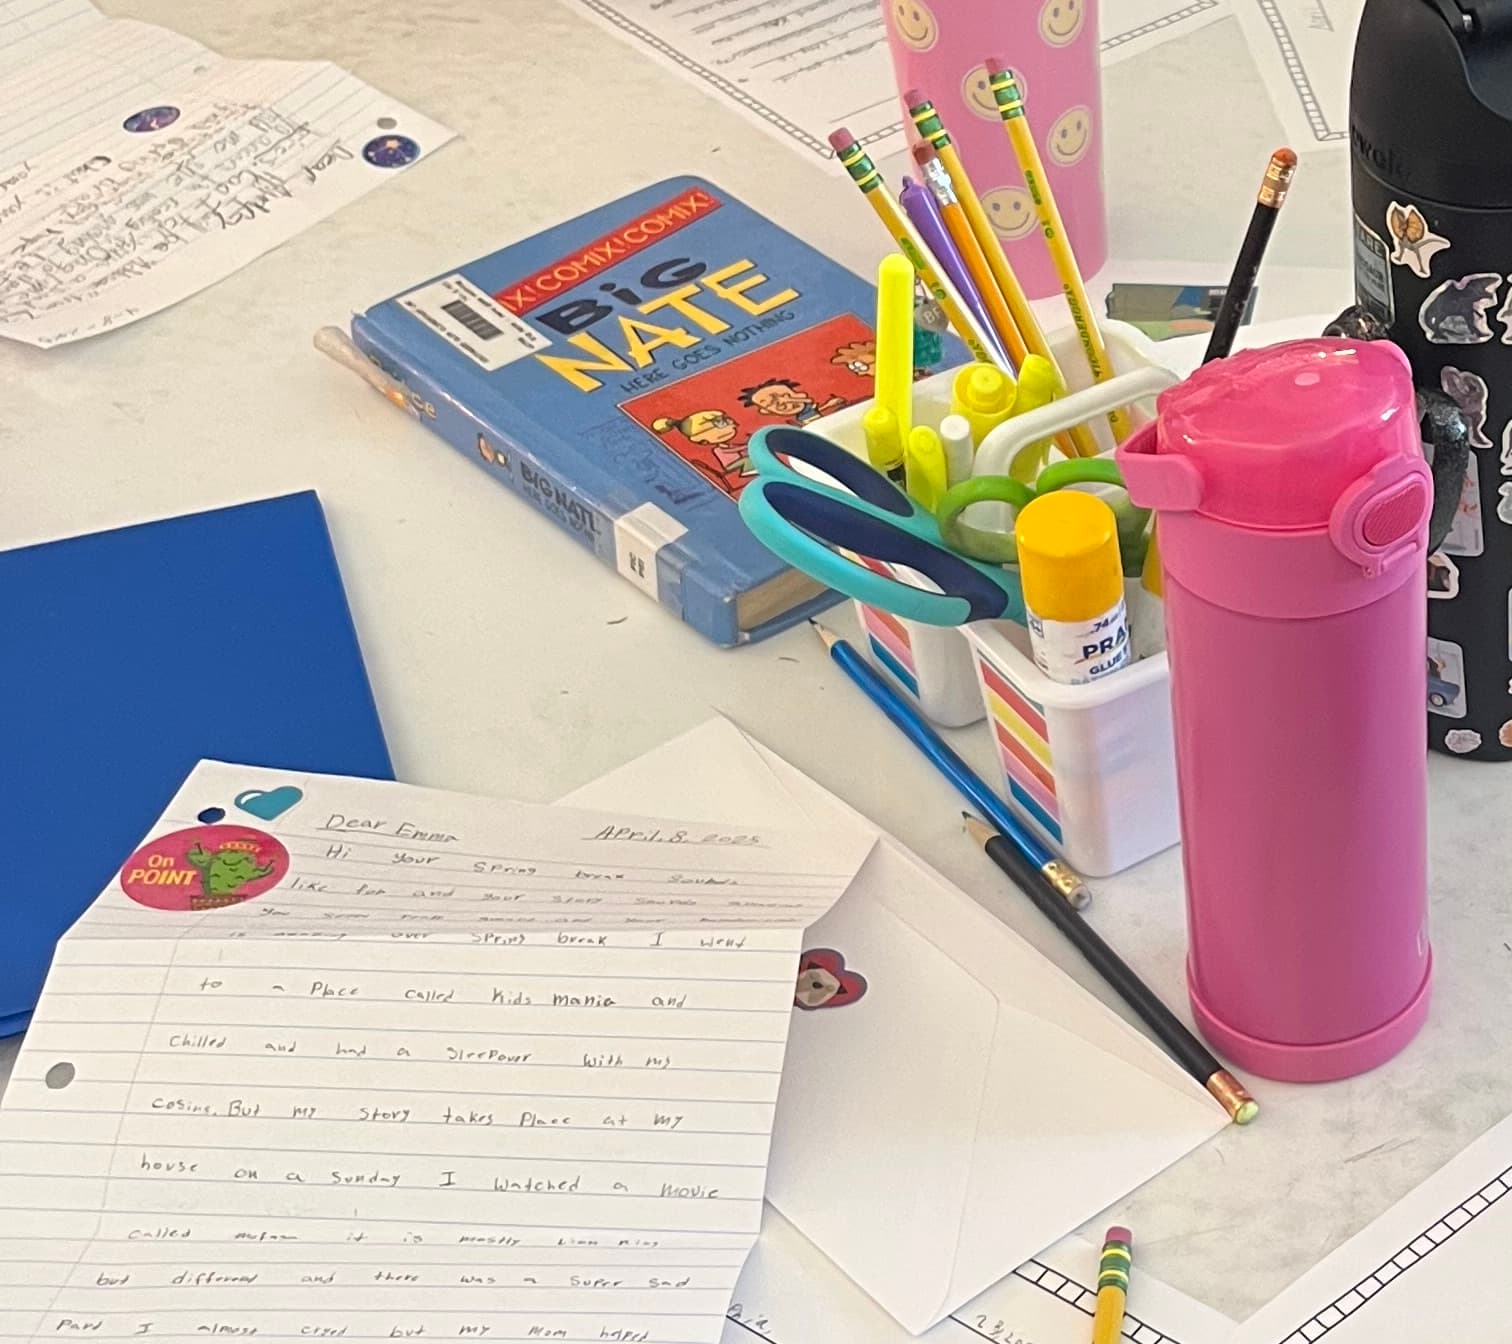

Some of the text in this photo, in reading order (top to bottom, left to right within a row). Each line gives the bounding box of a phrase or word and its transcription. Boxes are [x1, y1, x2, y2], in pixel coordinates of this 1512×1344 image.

[534, 189, 711, 293] COMIX! COMIX!
[534, 258, 802, 393] NATE
[621, 310, 798, 394] HERE GOES NOTHING
[1083, 625, 1128, 660] PRA
[1089, 655, 1122, 675] GLUE
[326, 813, 386, 832] Dear
[397, 822, 458, 843] Emma
[148, 854, 174, 869] On
[326, 844, 350, 860] Hi
[127, 869, 197, 886] POINT
[201, 978, 223, 993] to
[651, 994, 688, 1009] and
[227, 1099, 262, 1119] But
[442, 1107, 495, 1126] takes
[653, 1112, 685, 1130] my
[438, 1169, 456, 1188] I
[135, 1321, 153, 1336] I
